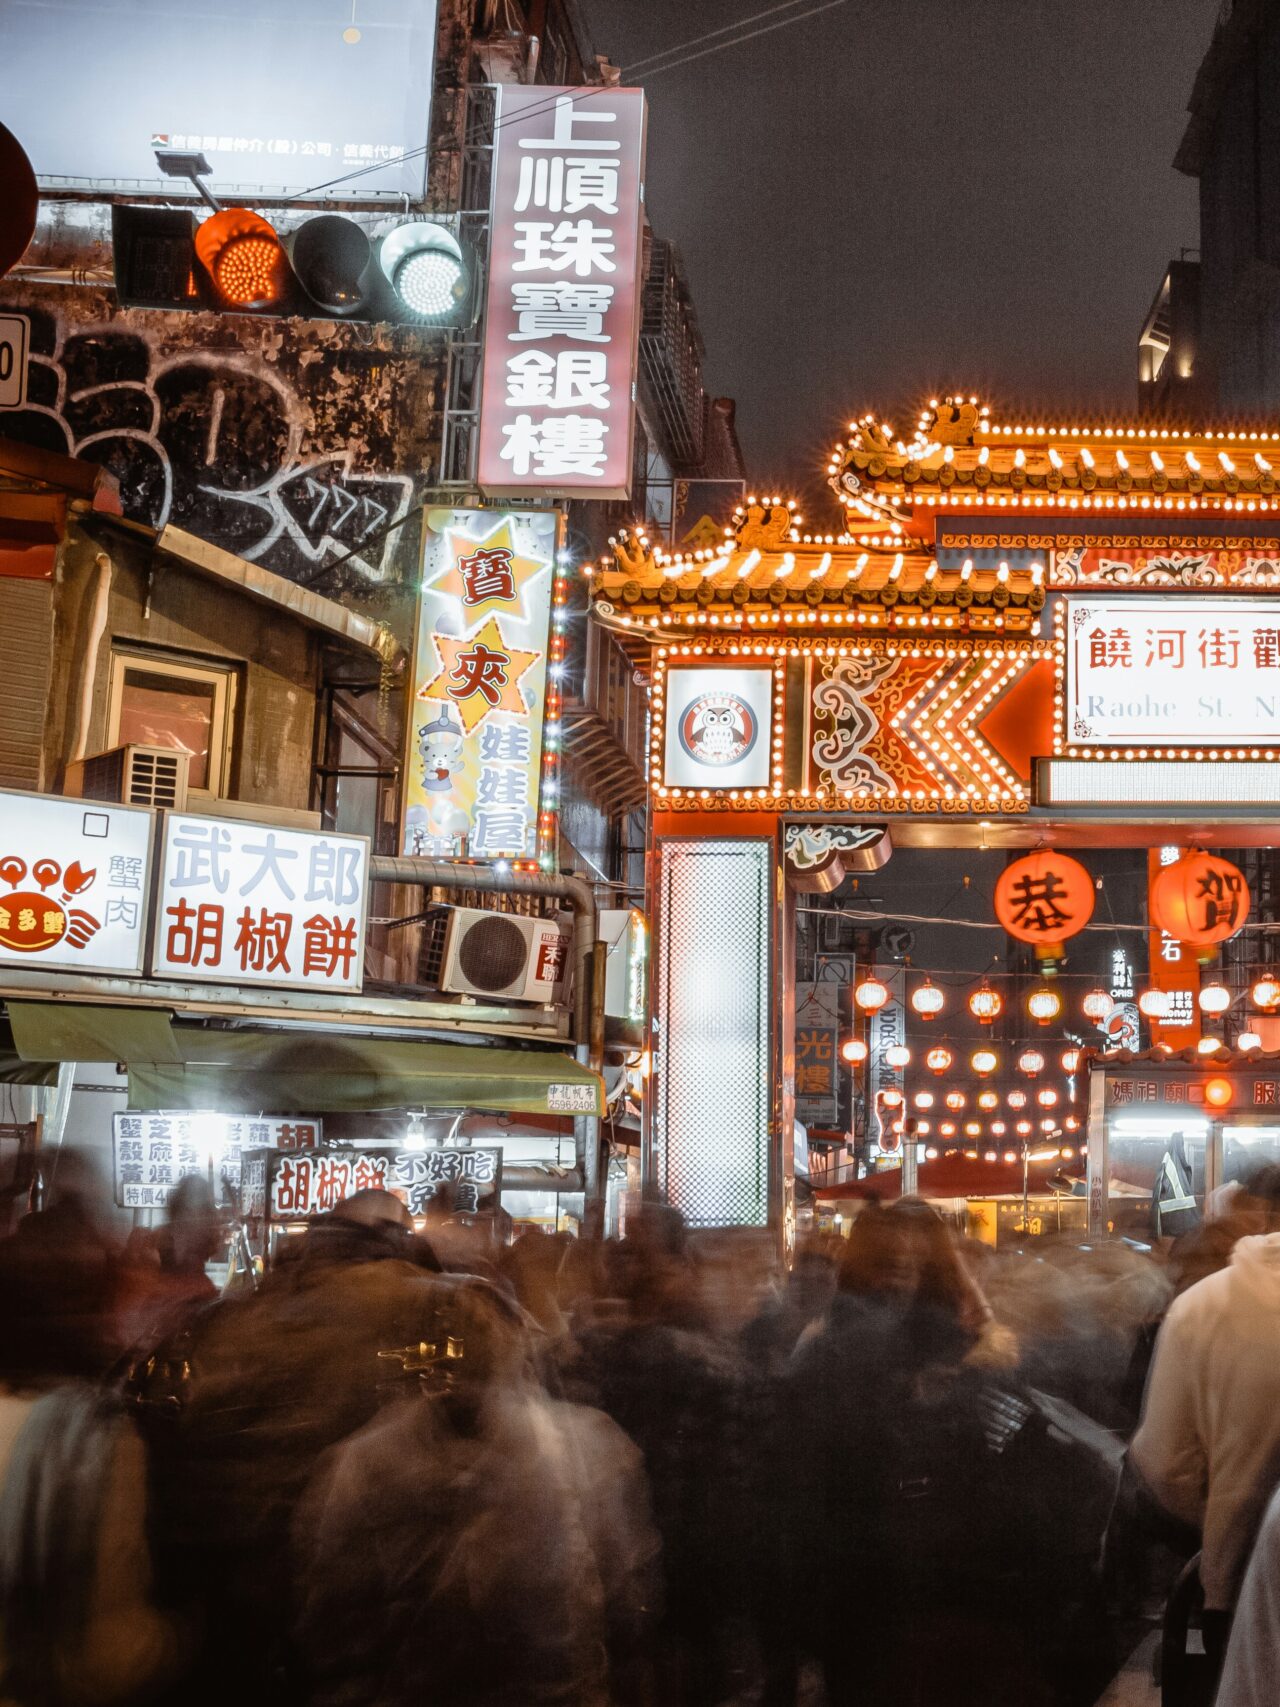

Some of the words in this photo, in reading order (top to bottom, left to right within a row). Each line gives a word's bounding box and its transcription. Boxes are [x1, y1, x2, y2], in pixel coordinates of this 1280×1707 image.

[500, 97, 620, 477] 上順珠寶銀樓
[1087, 695, 1177, 718] Raohe
[1197, 695, 1232, 718] St.
[474, 723, 531, 853] 娃娃屋
[104, 855, 142, 930] 蟹肉
[171, 824, 361, 906] 武大郎
[1009, 872, 1073, 930] 恭
[1196, 868, 1241, 931] 賀
[165, 898, 358, 980] 胡椒餅
[1110, 988, 1133, 998] ORIS
[1113, 1080, 1207, 1105] 媽祖廟口
[276, 1157, 387, 1213] 胡椒餅
[396, 1151, 494, 1184] 不好吃
